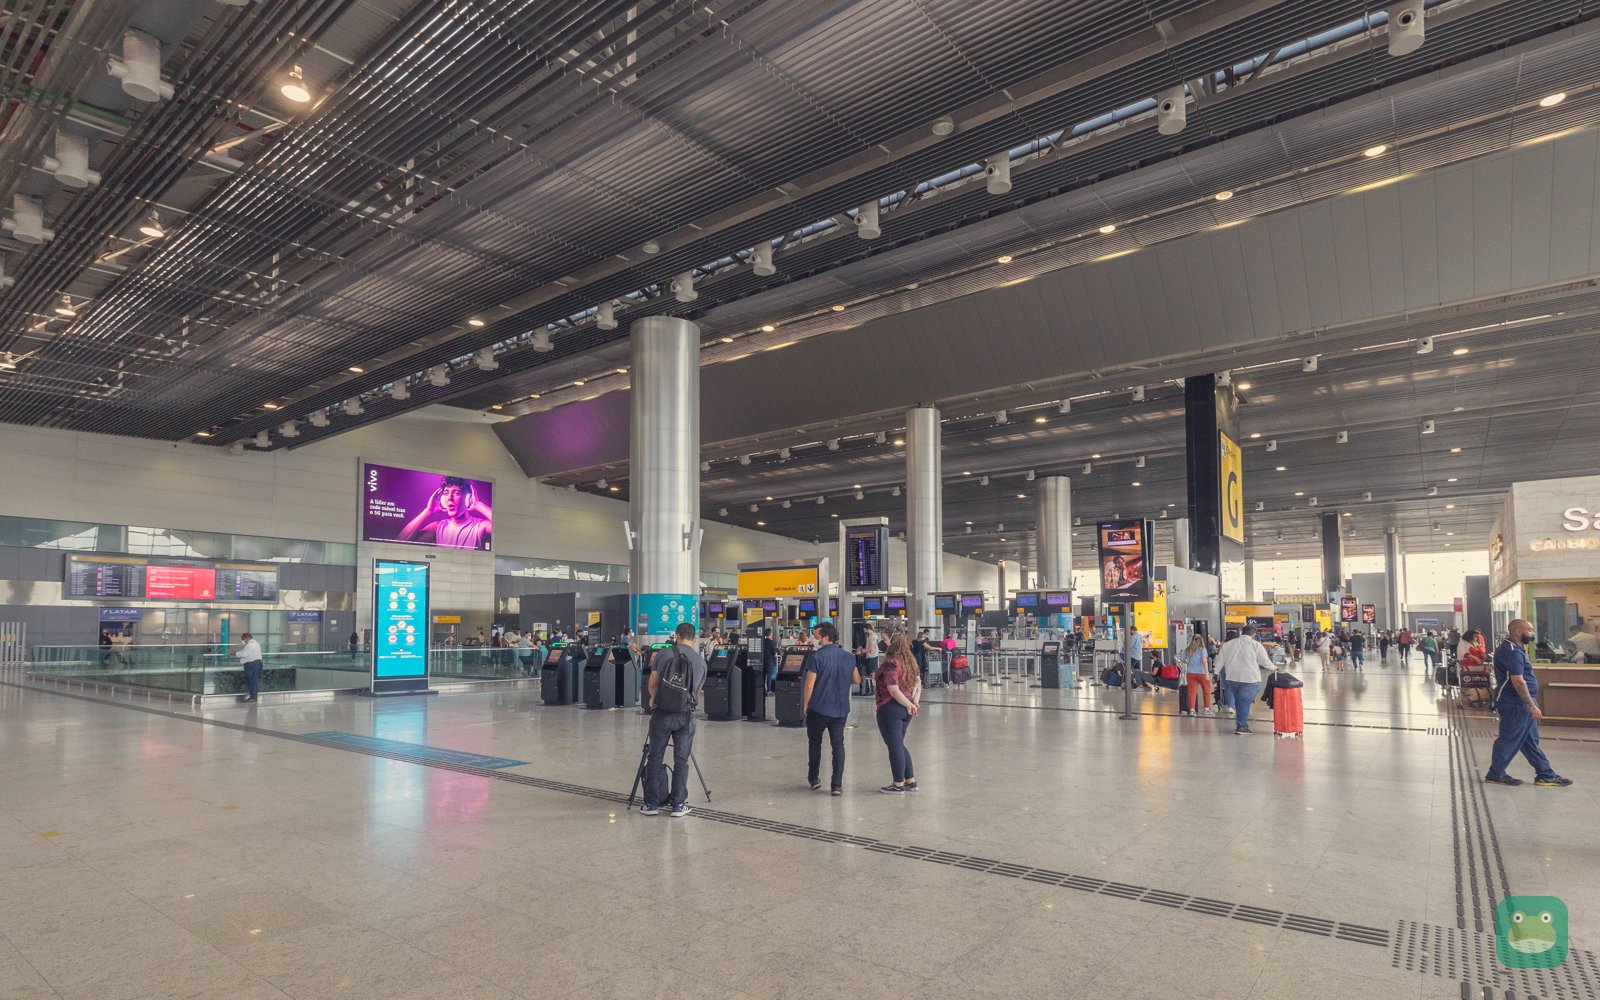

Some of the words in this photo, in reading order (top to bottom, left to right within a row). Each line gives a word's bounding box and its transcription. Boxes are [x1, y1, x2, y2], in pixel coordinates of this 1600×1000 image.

[368, 469, 377, 491] vivo
[1228, 471, 1238, 528] G
[1530, 537, 1599, 552] CÂMBIO
